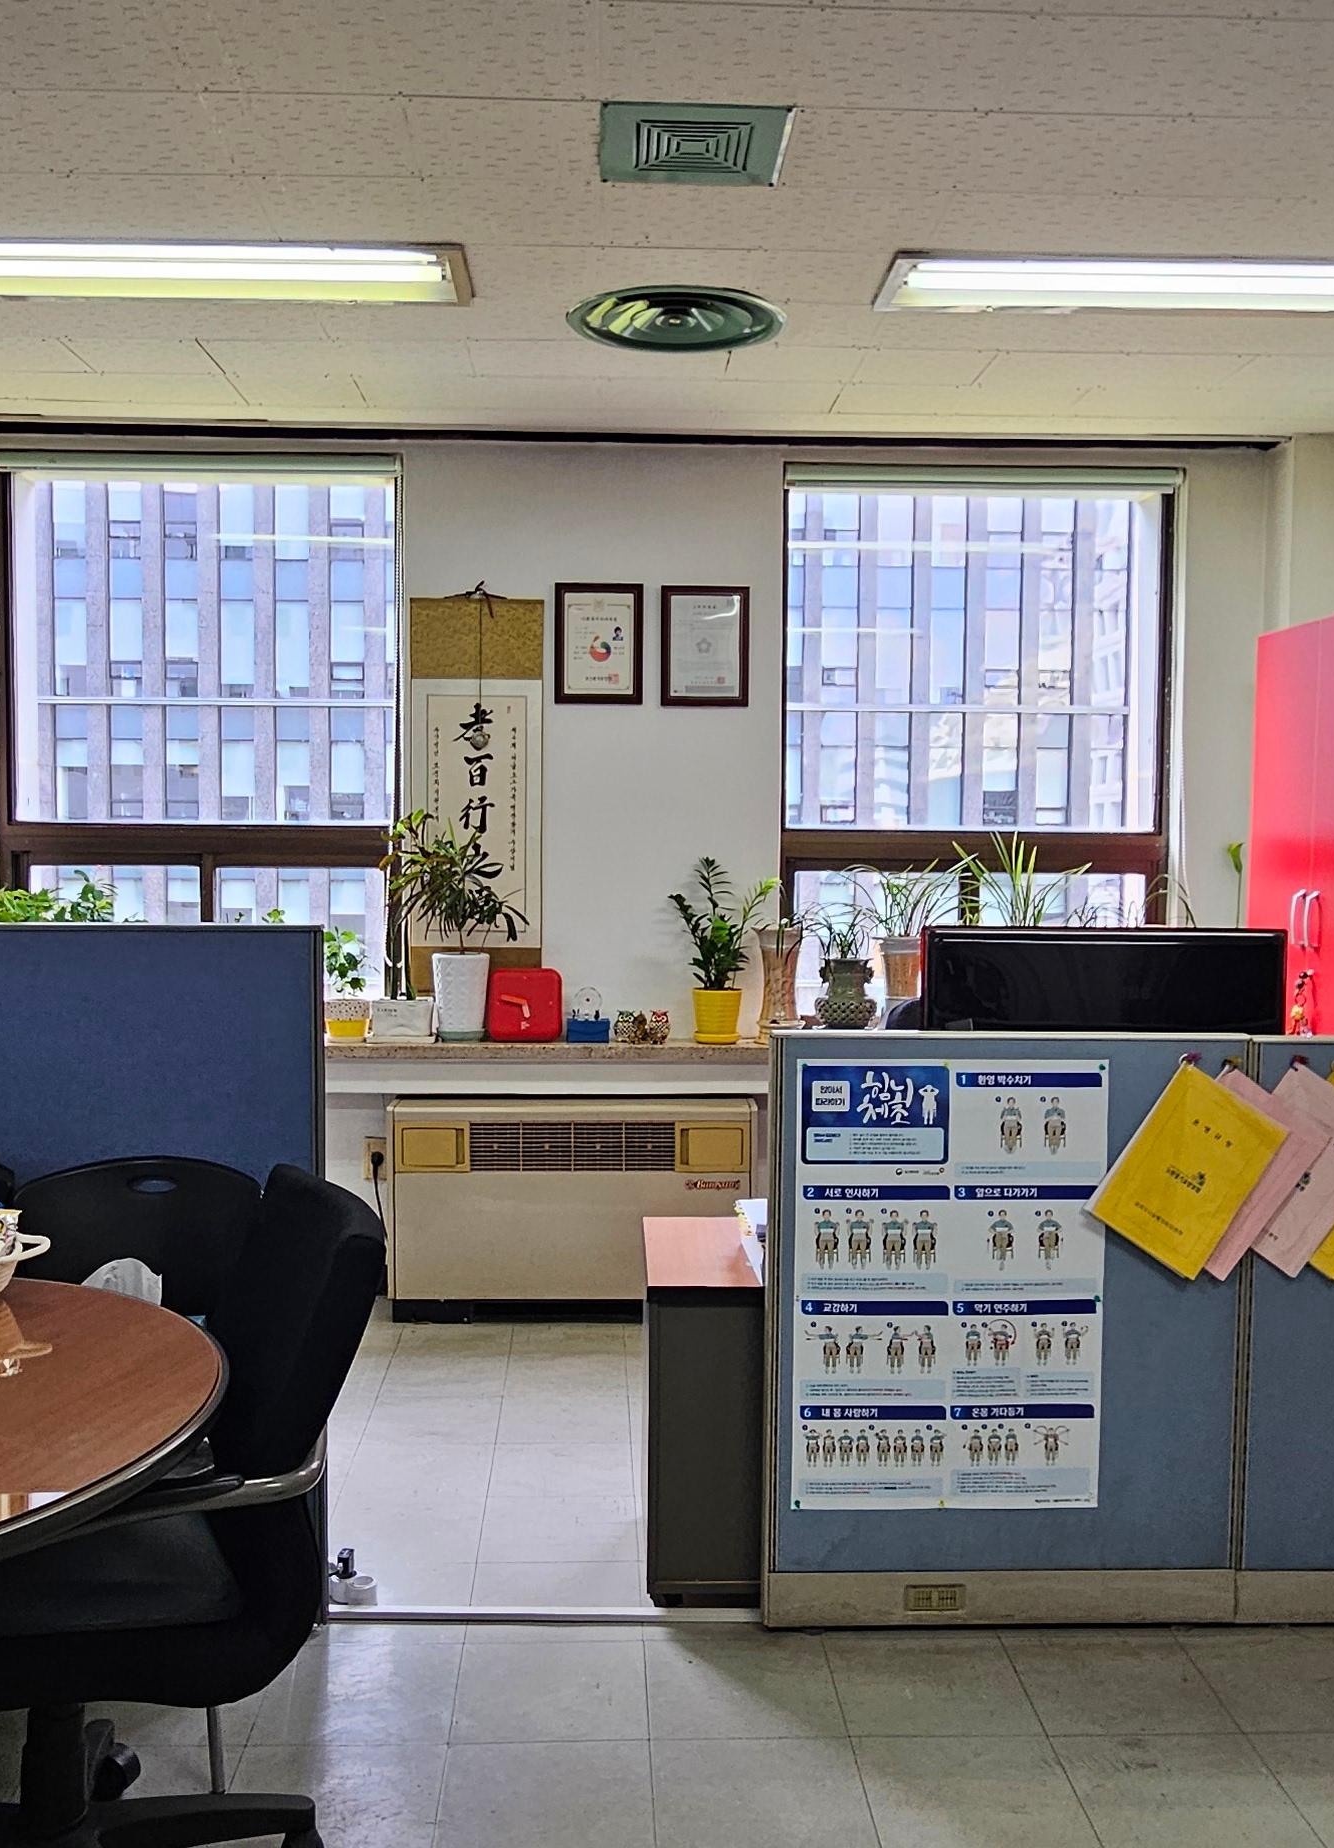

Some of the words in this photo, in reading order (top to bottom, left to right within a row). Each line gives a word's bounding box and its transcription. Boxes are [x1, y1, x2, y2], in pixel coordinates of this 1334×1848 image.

[960, 1075, 966, 1084] 1
[977, 1075, 996, 1086] 환영
[997, 1075, 1031, 1086] 박수치기
[820, 1085, 843, 1095] 앉아서
[815, 1097, 846, 1107] 따라하기
[857, 1094, 911, 1125] 체조
[807, 1187, 814, 1198] 2
[824, 1188, 843, 1198] 서로
[845, 1187, 879, 1198] 인사하기
[958, 1187, 966, 1198] 3
[975, 1187, 1002, 1198] 앞으로
[1004, 1187, 1037, 1198] 다가가기
[805, 1302, 813, 1312] 4
[823, 1303, 857, 1313] 교감하기
[957, 1303, 964, 1313] 5
[974, 1303, 992, 1313] 악기
[994, 1302, 1027, 1313] 연주하기
[804, 1408, 812, 1418] 6
[821, 1408, 831, 1418] 내
[833, 1408, 842, 1418] 몸
[843, 1408, 878, 1418] 사랑하기
[954, 1408, 961, 1417] 7
[972, 1407, 989, 1417] 온몸
[990, 1407, 1025, 1417] 가다듬기
